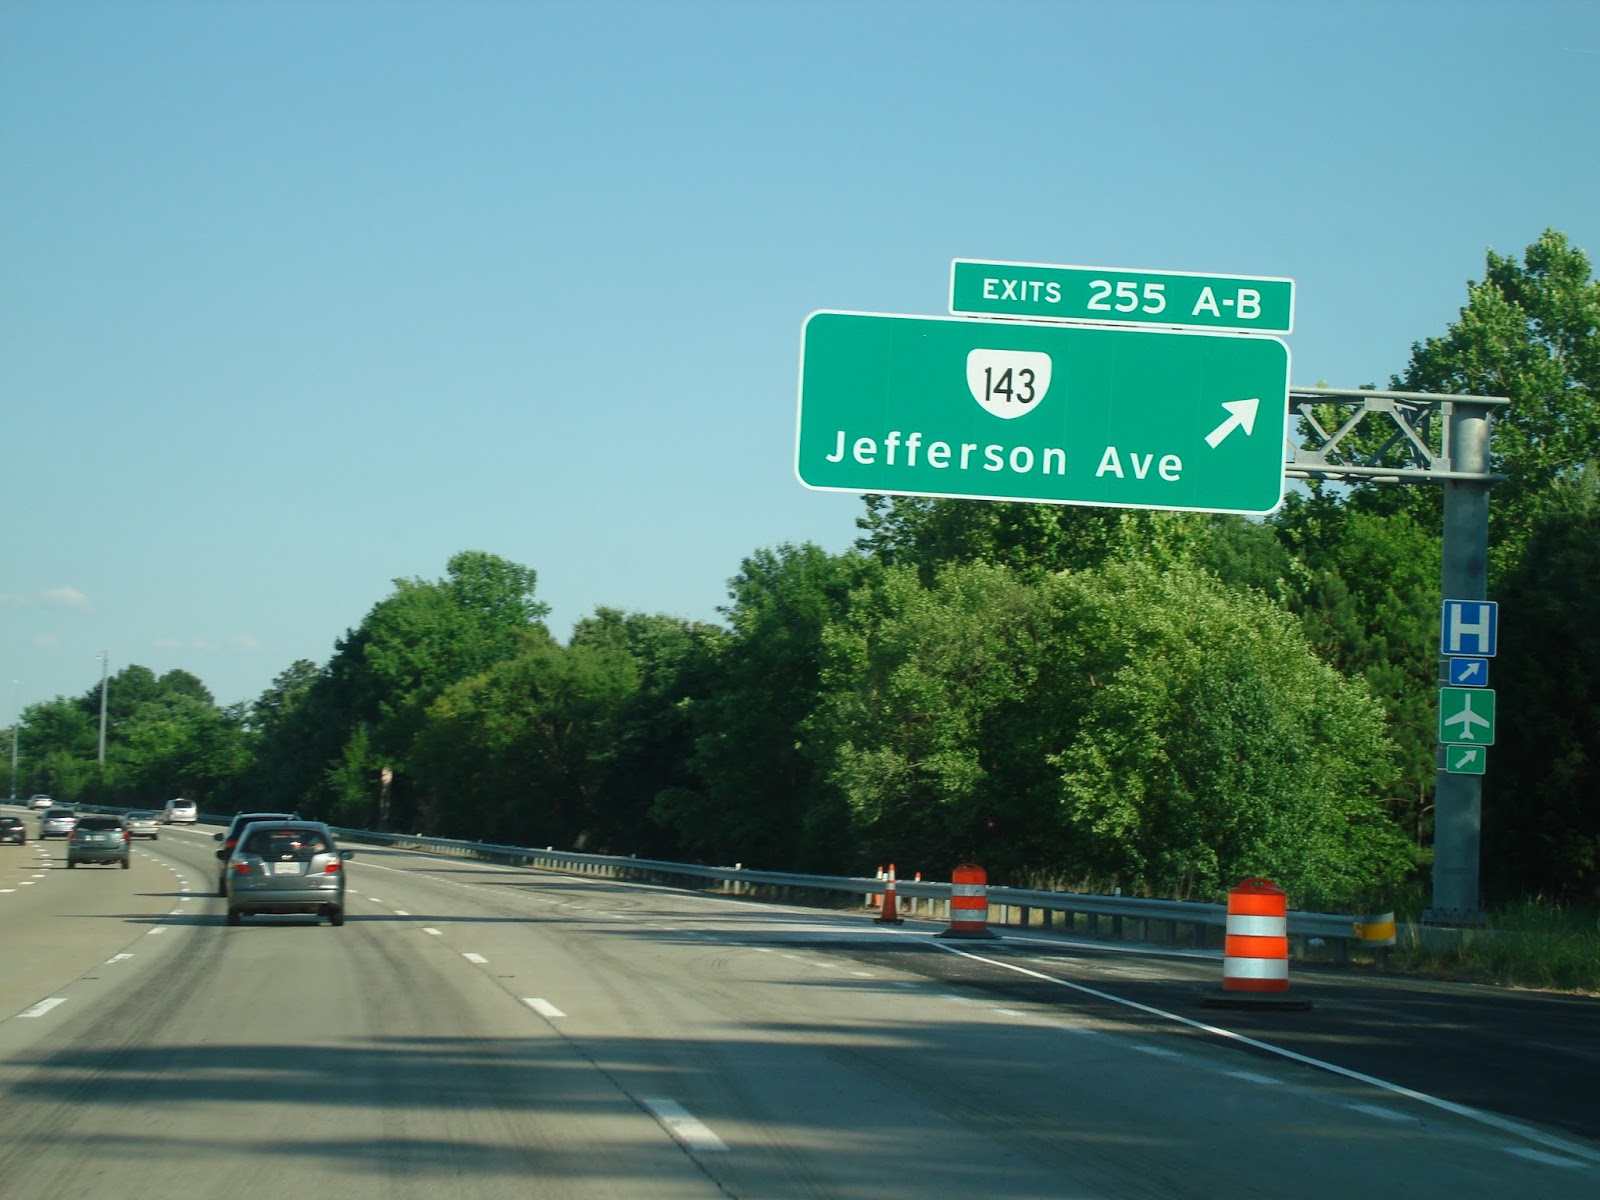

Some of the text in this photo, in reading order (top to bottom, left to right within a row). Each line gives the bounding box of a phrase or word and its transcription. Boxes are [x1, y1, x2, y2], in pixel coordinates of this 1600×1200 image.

[982, 278, 1262, 320] EXITS 255 A-B
[983, 366, 1037, 405] 143
[825, 430, 1184, 482] Jefferson Ave
[1450, 603, 1490, 653] H
